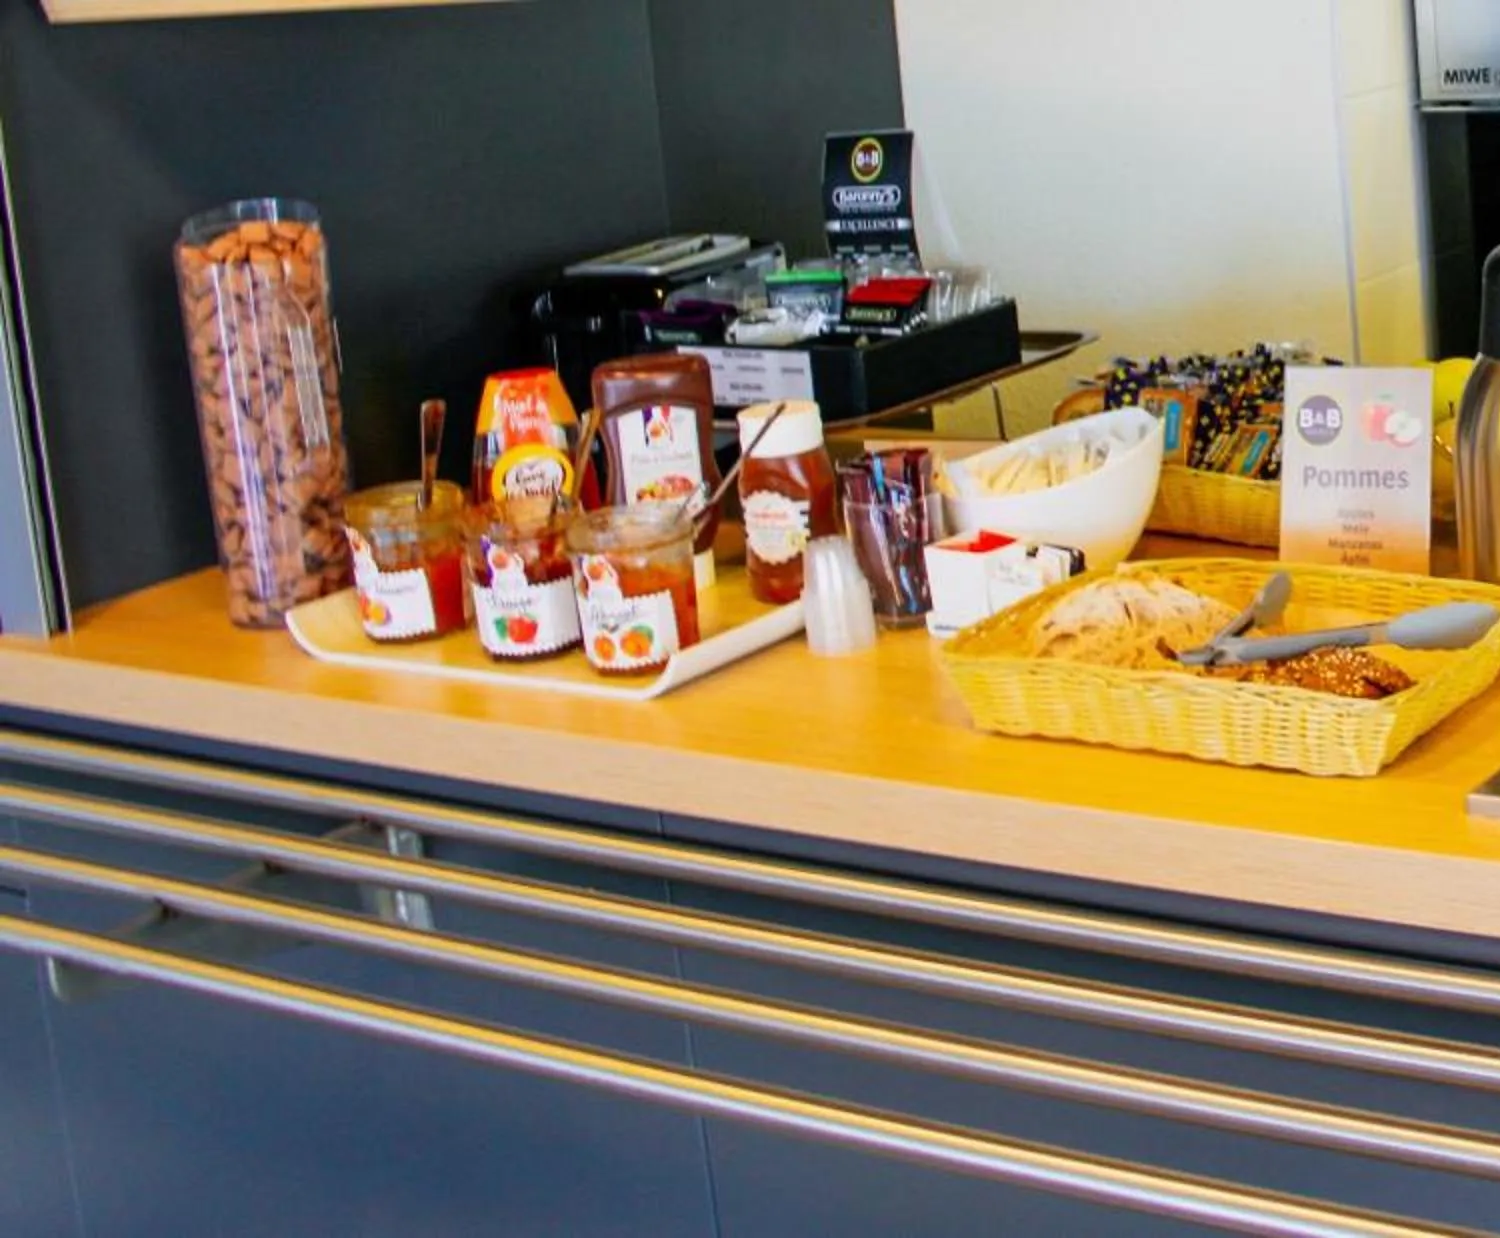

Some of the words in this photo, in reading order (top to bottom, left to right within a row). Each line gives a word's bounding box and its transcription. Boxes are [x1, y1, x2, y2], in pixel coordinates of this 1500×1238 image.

[1443, 67, 1490, 84] MIWE
[1300, 408, 1341, 428] B&B
[1303, 464, 1409, 489] Pommes
